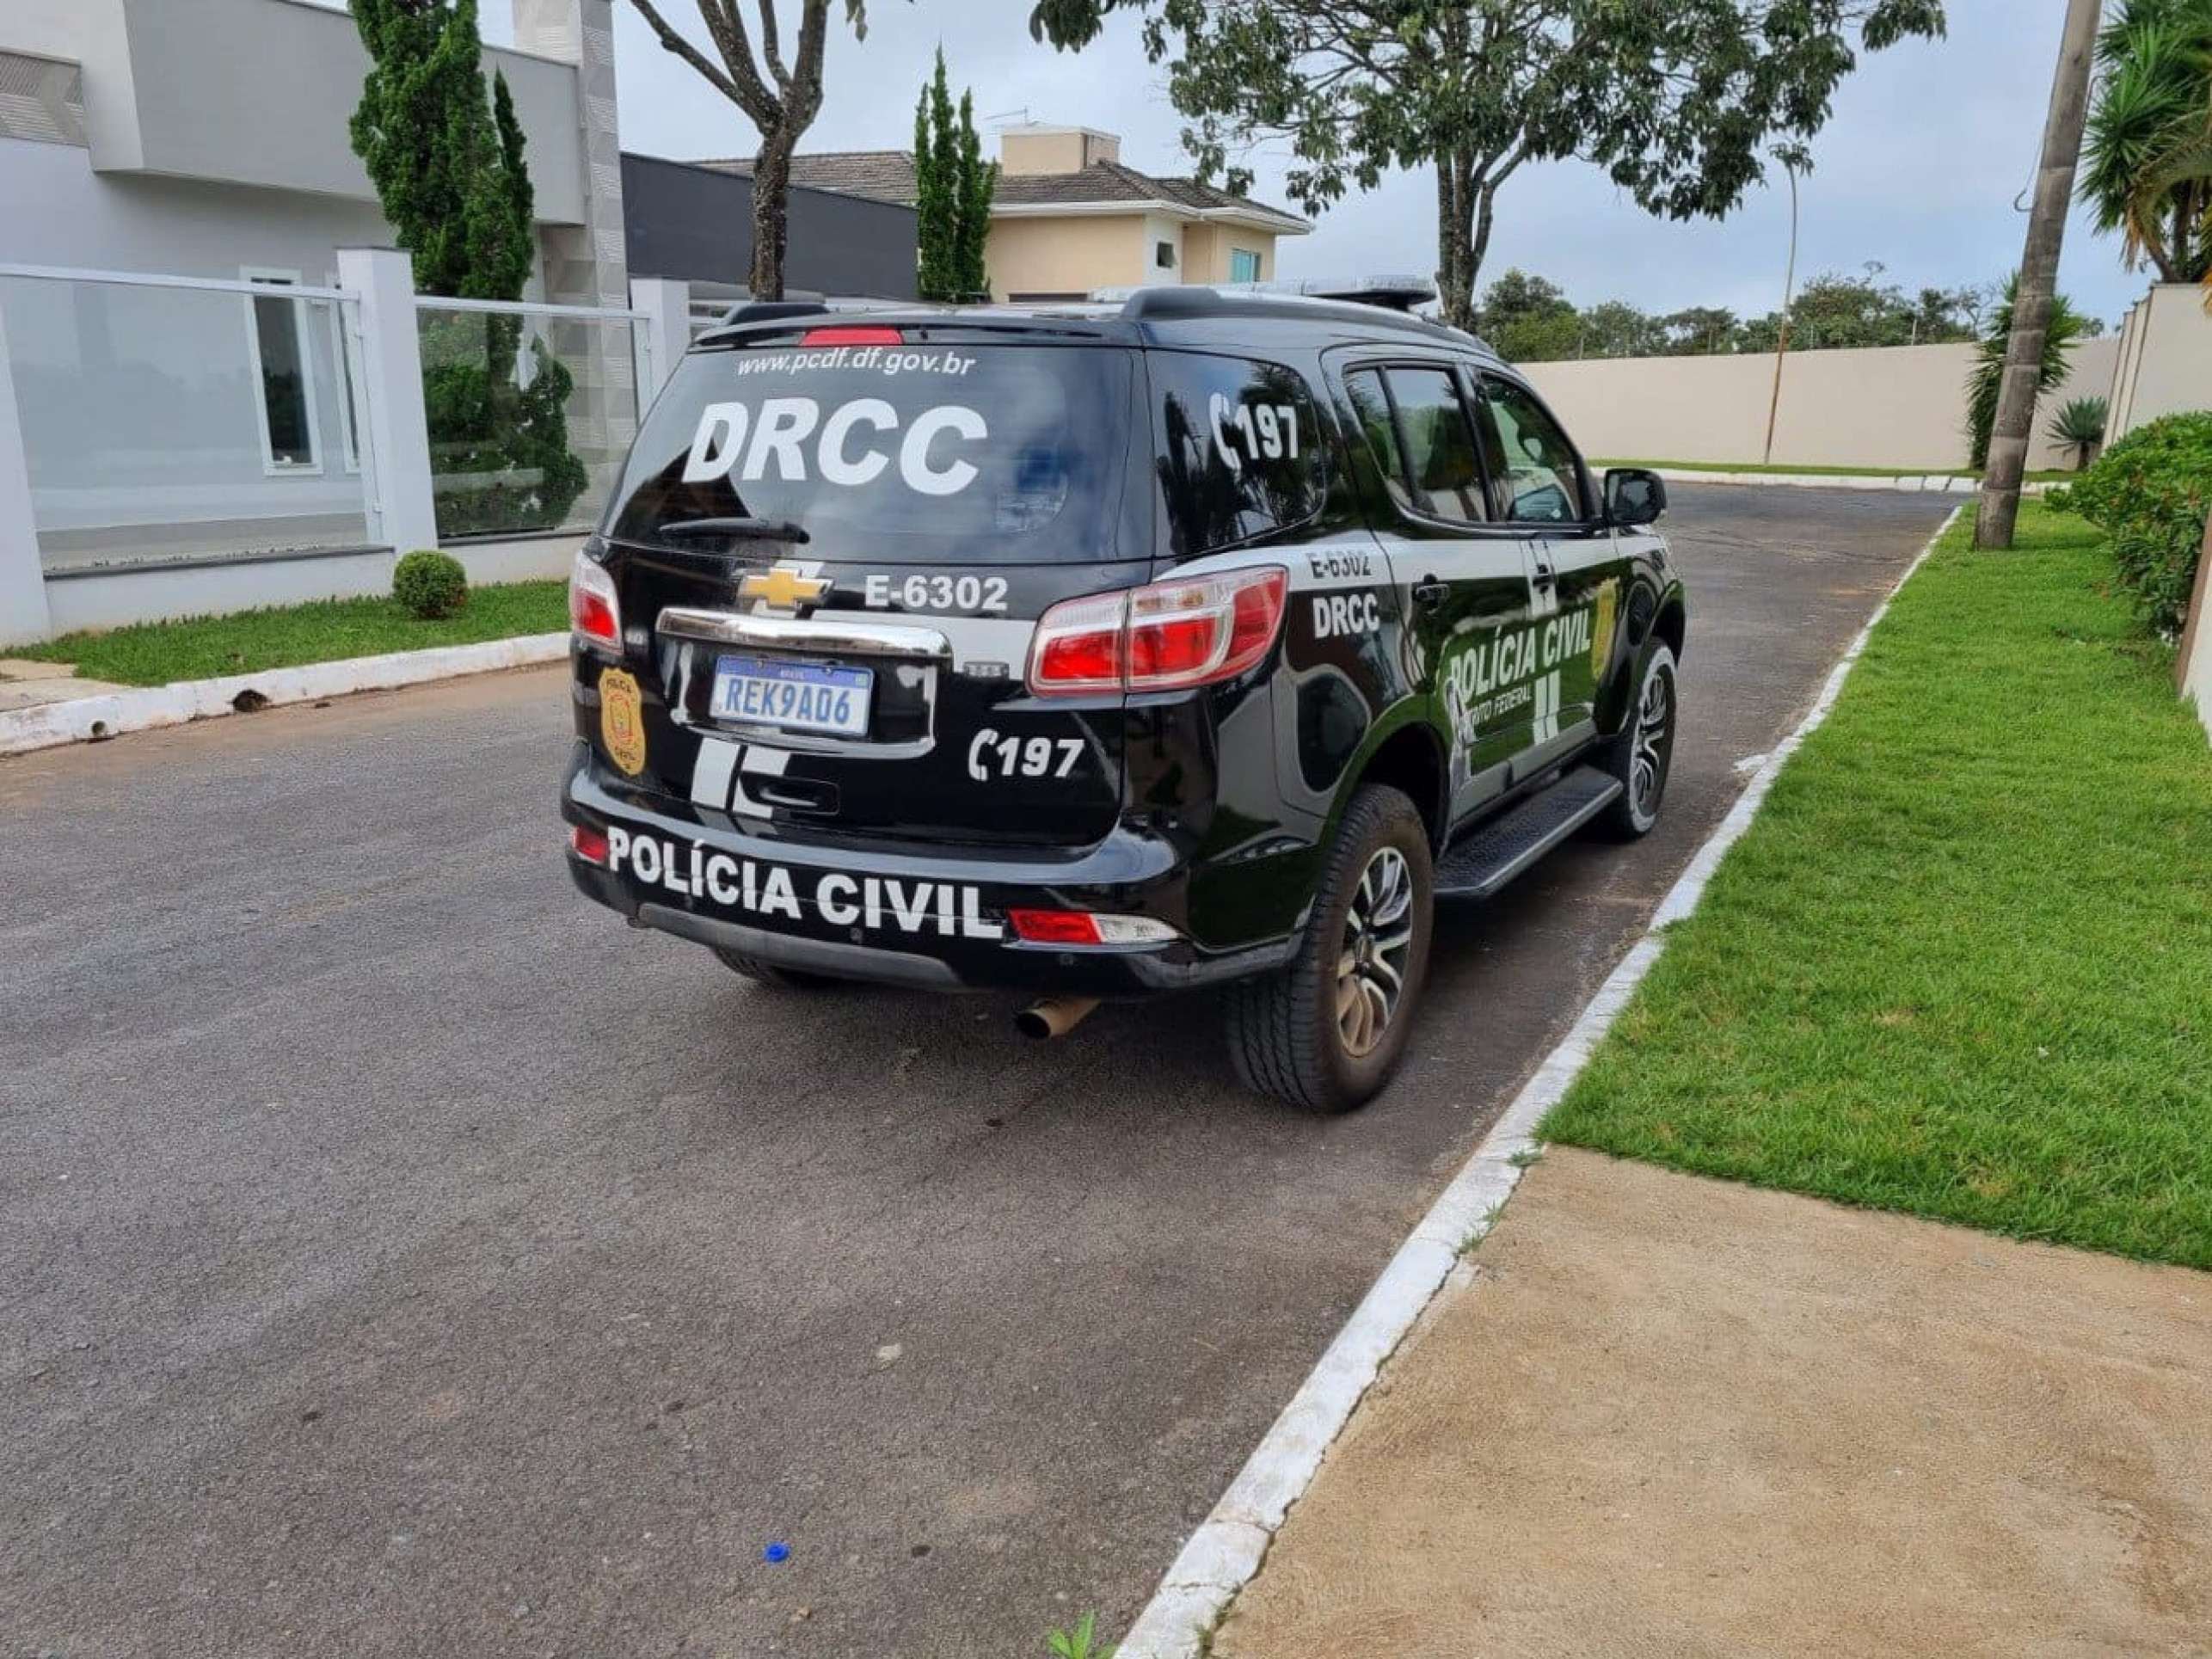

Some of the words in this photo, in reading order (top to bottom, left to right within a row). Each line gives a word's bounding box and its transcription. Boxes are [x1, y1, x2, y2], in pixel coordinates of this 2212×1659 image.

[738, 347, 976, 376] www.pcdf.df.gov.br
[681, 396, 988, 495] DRCC
[1234, 403, 1299, 460] 197
[864, 574, 1009, 611] E-6302
[1312, 593, 1380, 638] DRCC
[1450, 625, 1535, 709] POLÍCIA
[1543, 608, 1591, 668] CIVIL
[725, 679, 851, 724] REK9A06
[995, 738, 1086, 777] 197
[607, 826, 803, 919] POLÍCIA
[815, 873, 1004, 940] CIVIL
